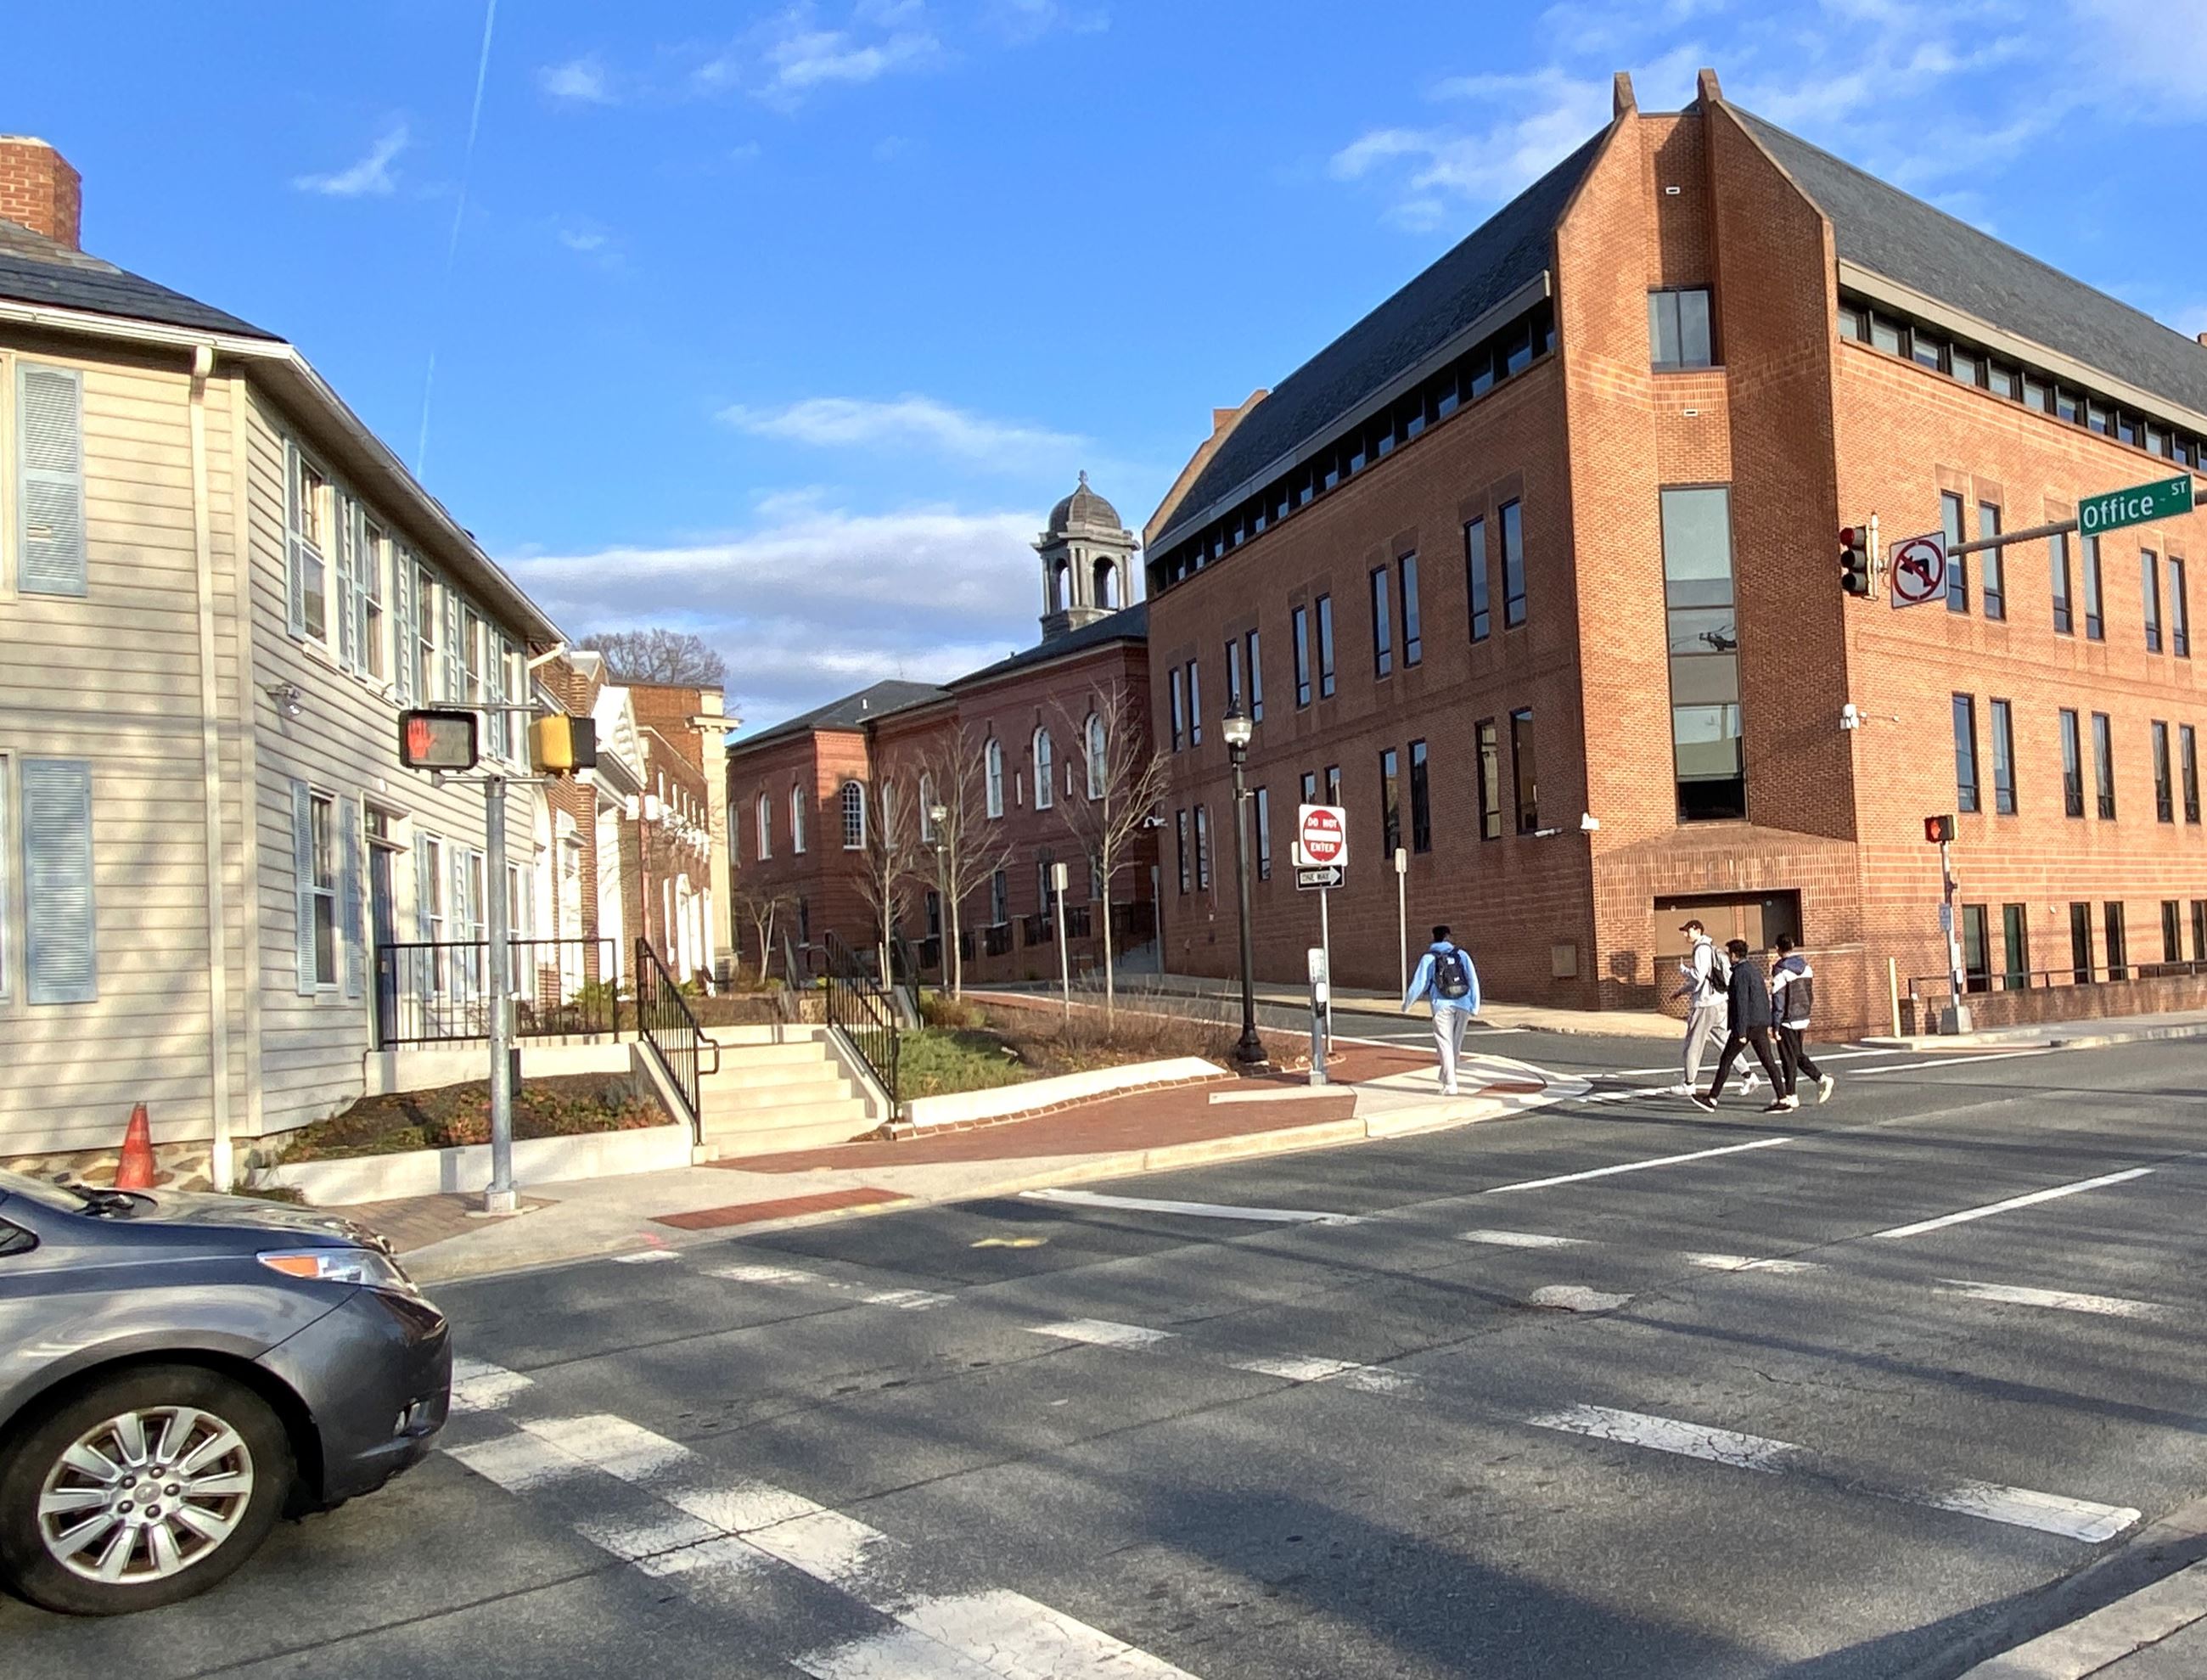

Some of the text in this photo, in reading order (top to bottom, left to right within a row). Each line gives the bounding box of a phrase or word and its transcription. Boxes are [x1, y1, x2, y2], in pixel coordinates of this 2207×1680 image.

[2083, 481, 2187, 528] Office ST
[1308, 817, 1337, 828] DO NOT
[1311, 842, 1334, 852] ENTER
[1302, 874, 1315, 882] ONE
